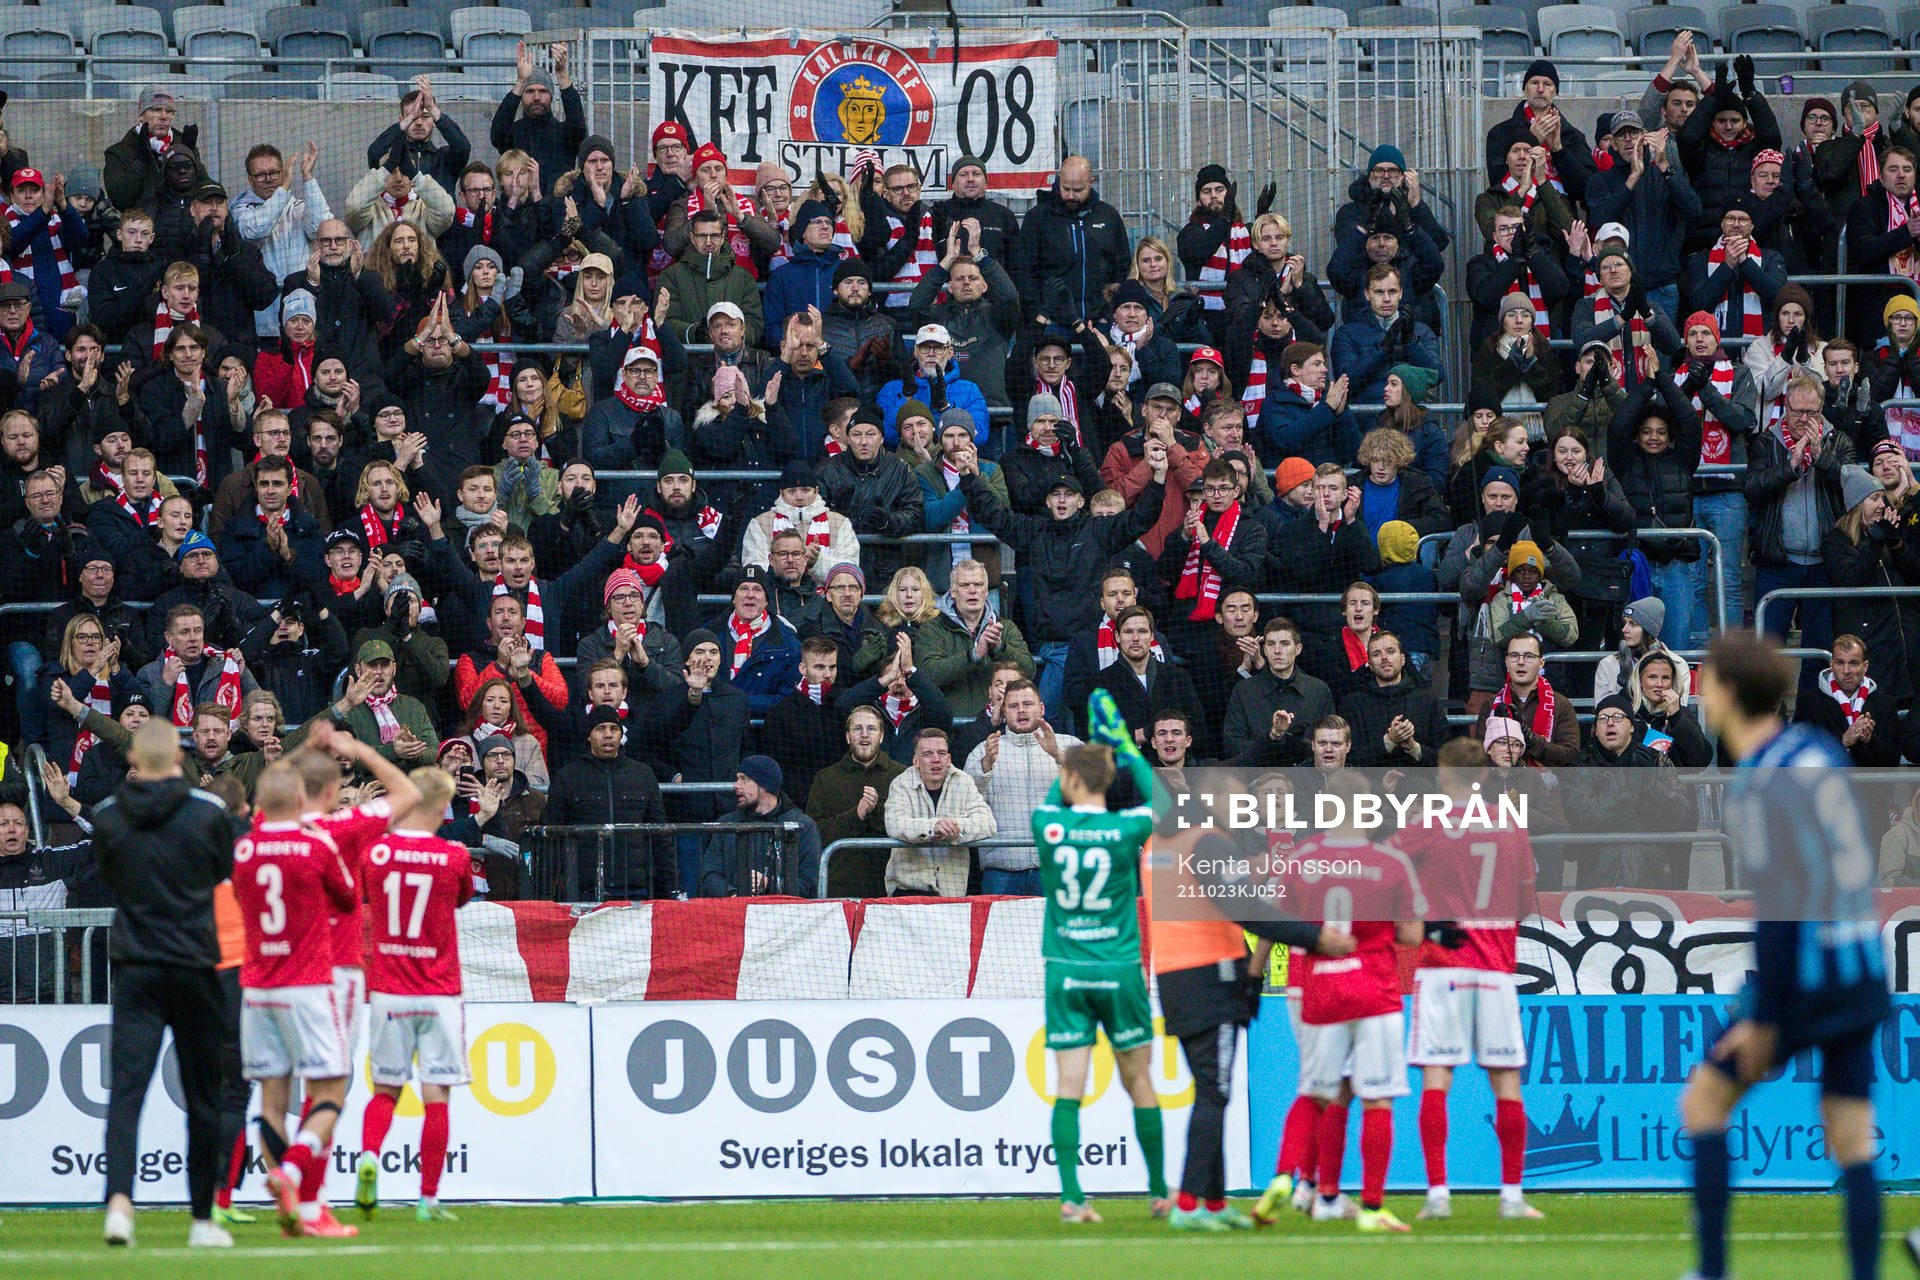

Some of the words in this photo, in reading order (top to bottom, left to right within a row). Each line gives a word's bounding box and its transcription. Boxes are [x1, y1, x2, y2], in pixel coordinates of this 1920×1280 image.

[802, 41, 892, 86] KALMAR
[895, 64, 922, 91] FF
[658, 62, 778, 163] KFF
[793, 105, 808, 119] 08
[915, 110, 930, 124] 08
[956, 65, 1036, 166] 08
[393, 849, 449, 867] REDEYE
[1053, 845, 1112, 911] 32
[1469, 841, 1498, 910] 7
[255, 864, 287, 936] 3
[383, 870, 433, 940] 17
[651, 1035, 992, 1101] JUST
[50, 1144, 190, 1183] Svege
[331, 1143, 468, 1174] trckri
[718, 1138, 869, 1177] Sveriges
[880, 1136, 984, 1168] lokala
[994, 1136, 1127, 1174] tryceri
